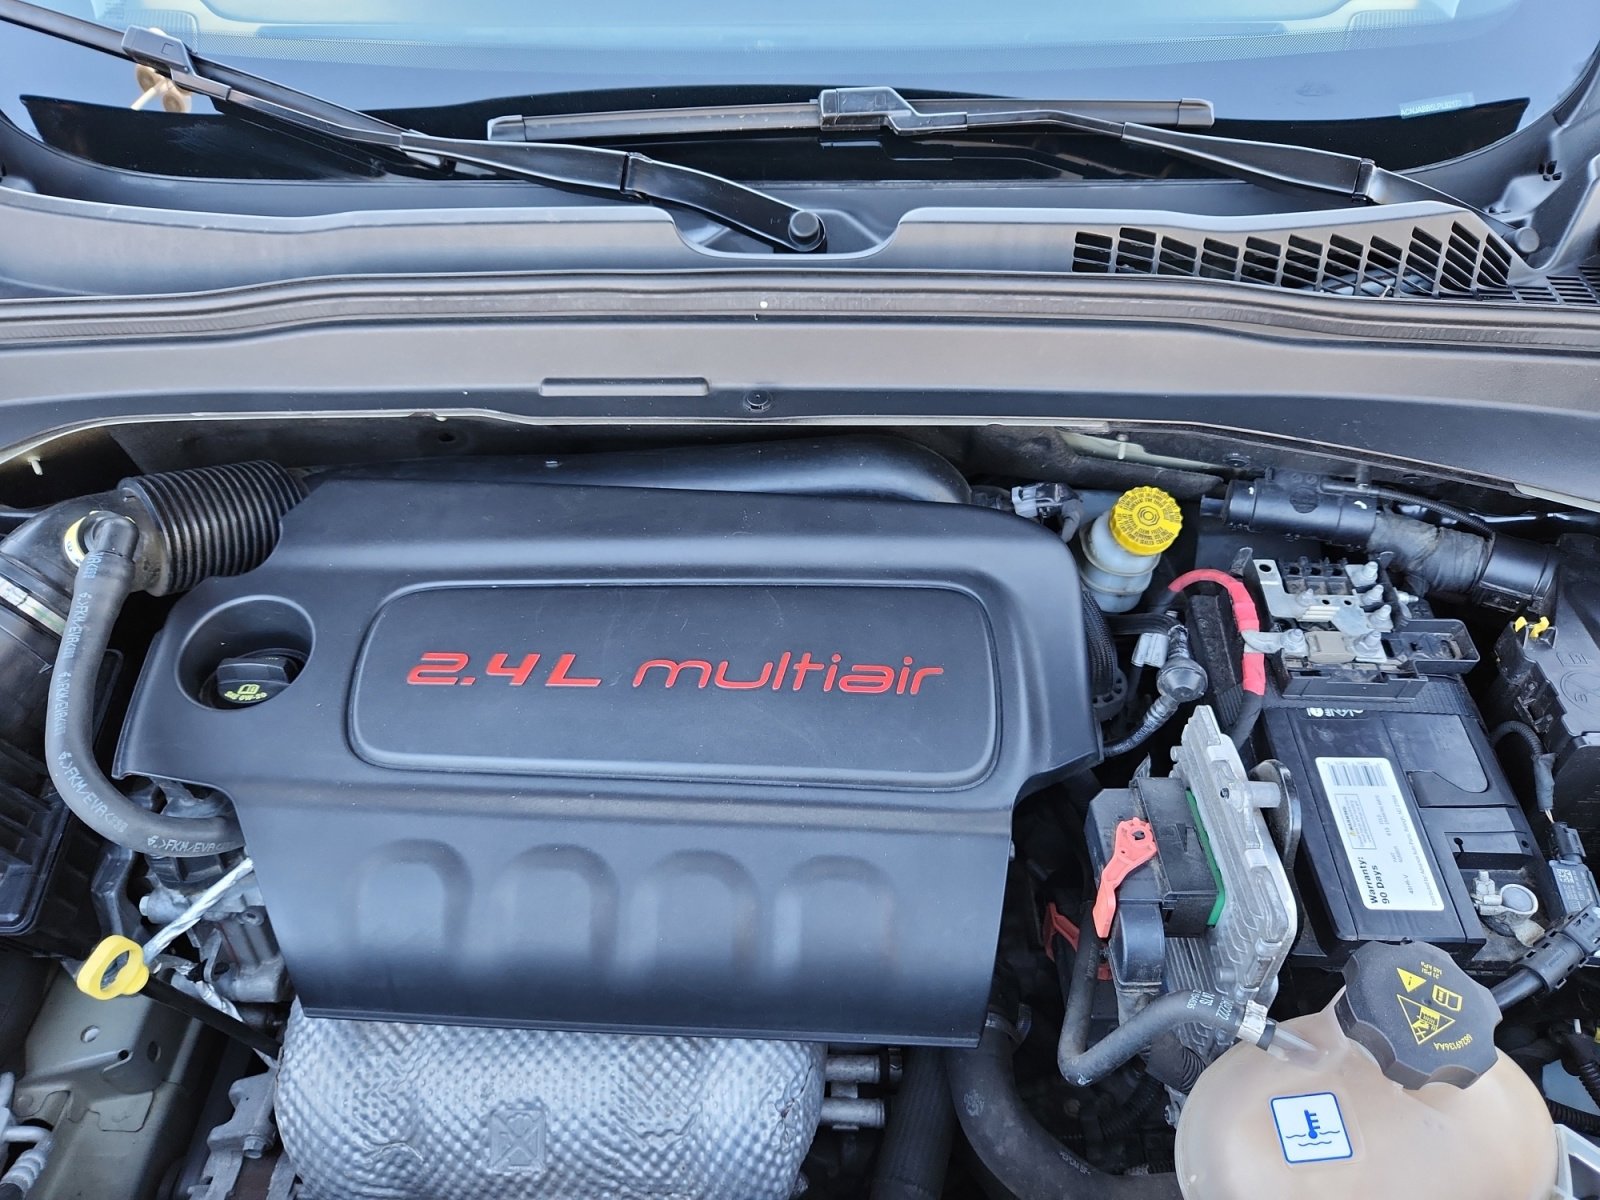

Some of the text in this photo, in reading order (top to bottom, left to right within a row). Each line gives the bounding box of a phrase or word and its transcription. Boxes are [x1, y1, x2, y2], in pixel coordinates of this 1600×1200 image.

[406, 651, 943, 695] 2.4 L multiair
[1358, 857, 1378, 904] Warranty:
[1372, 865, 1390, 904] 90 Days
